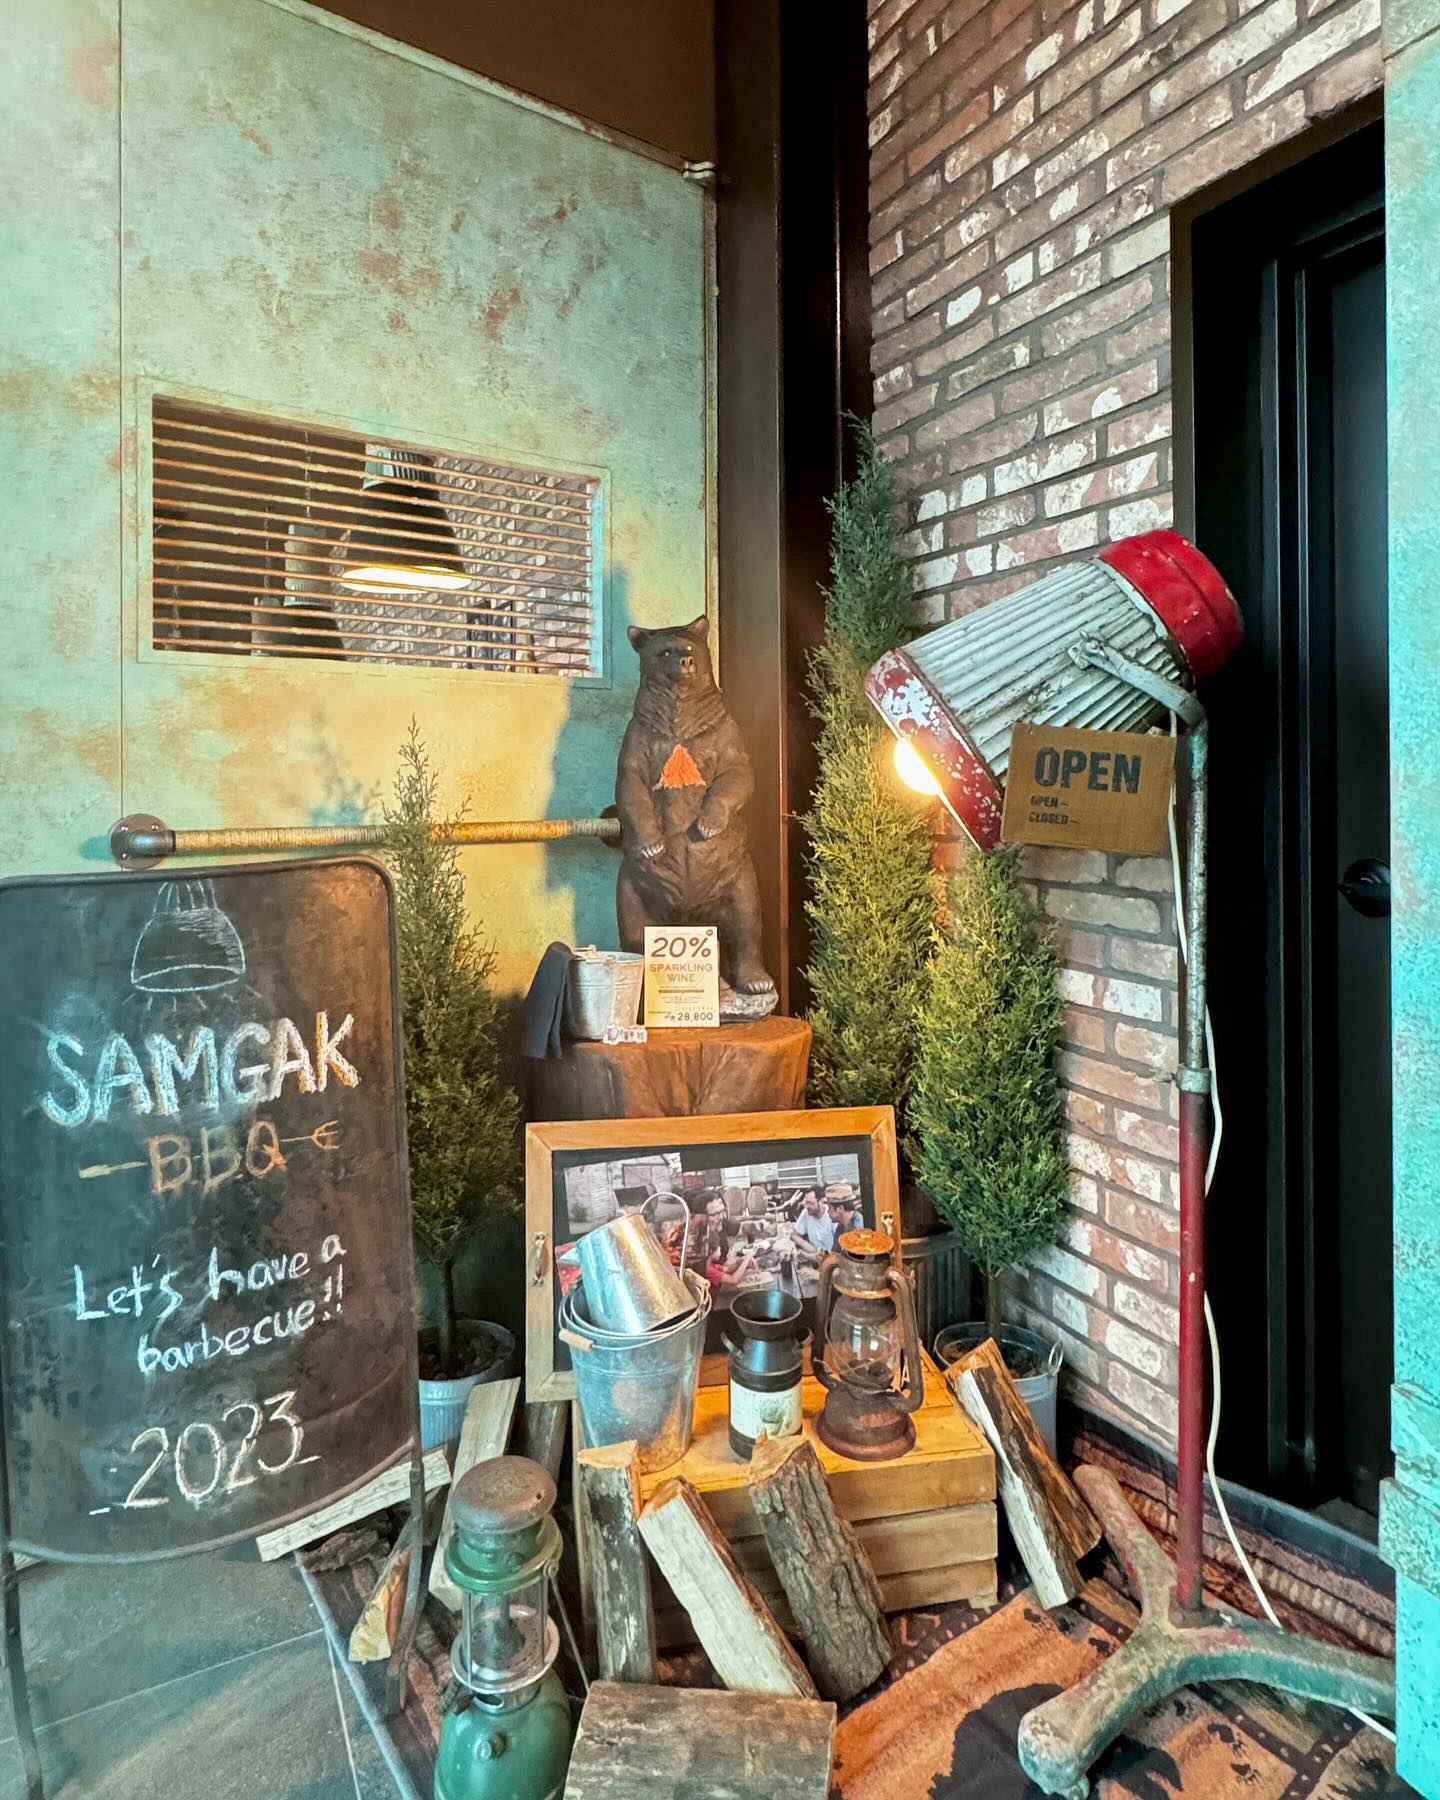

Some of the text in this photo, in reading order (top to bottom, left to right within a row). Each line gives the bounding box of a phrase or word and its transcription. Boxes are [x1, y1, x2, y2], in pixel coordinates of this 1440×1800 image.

[1034, 747, 1142, 794] OPEN
[650, 963, 713, 973] SPARKLING
[651, 936, 712, 958] 20%
[667, 973, 696, 982] WINE
[40, 1011, 361, 1127] SAMGAK
[149, 1120, 288, 1193] BBQ
[74, 1234, 347, 1320] Let's have a
